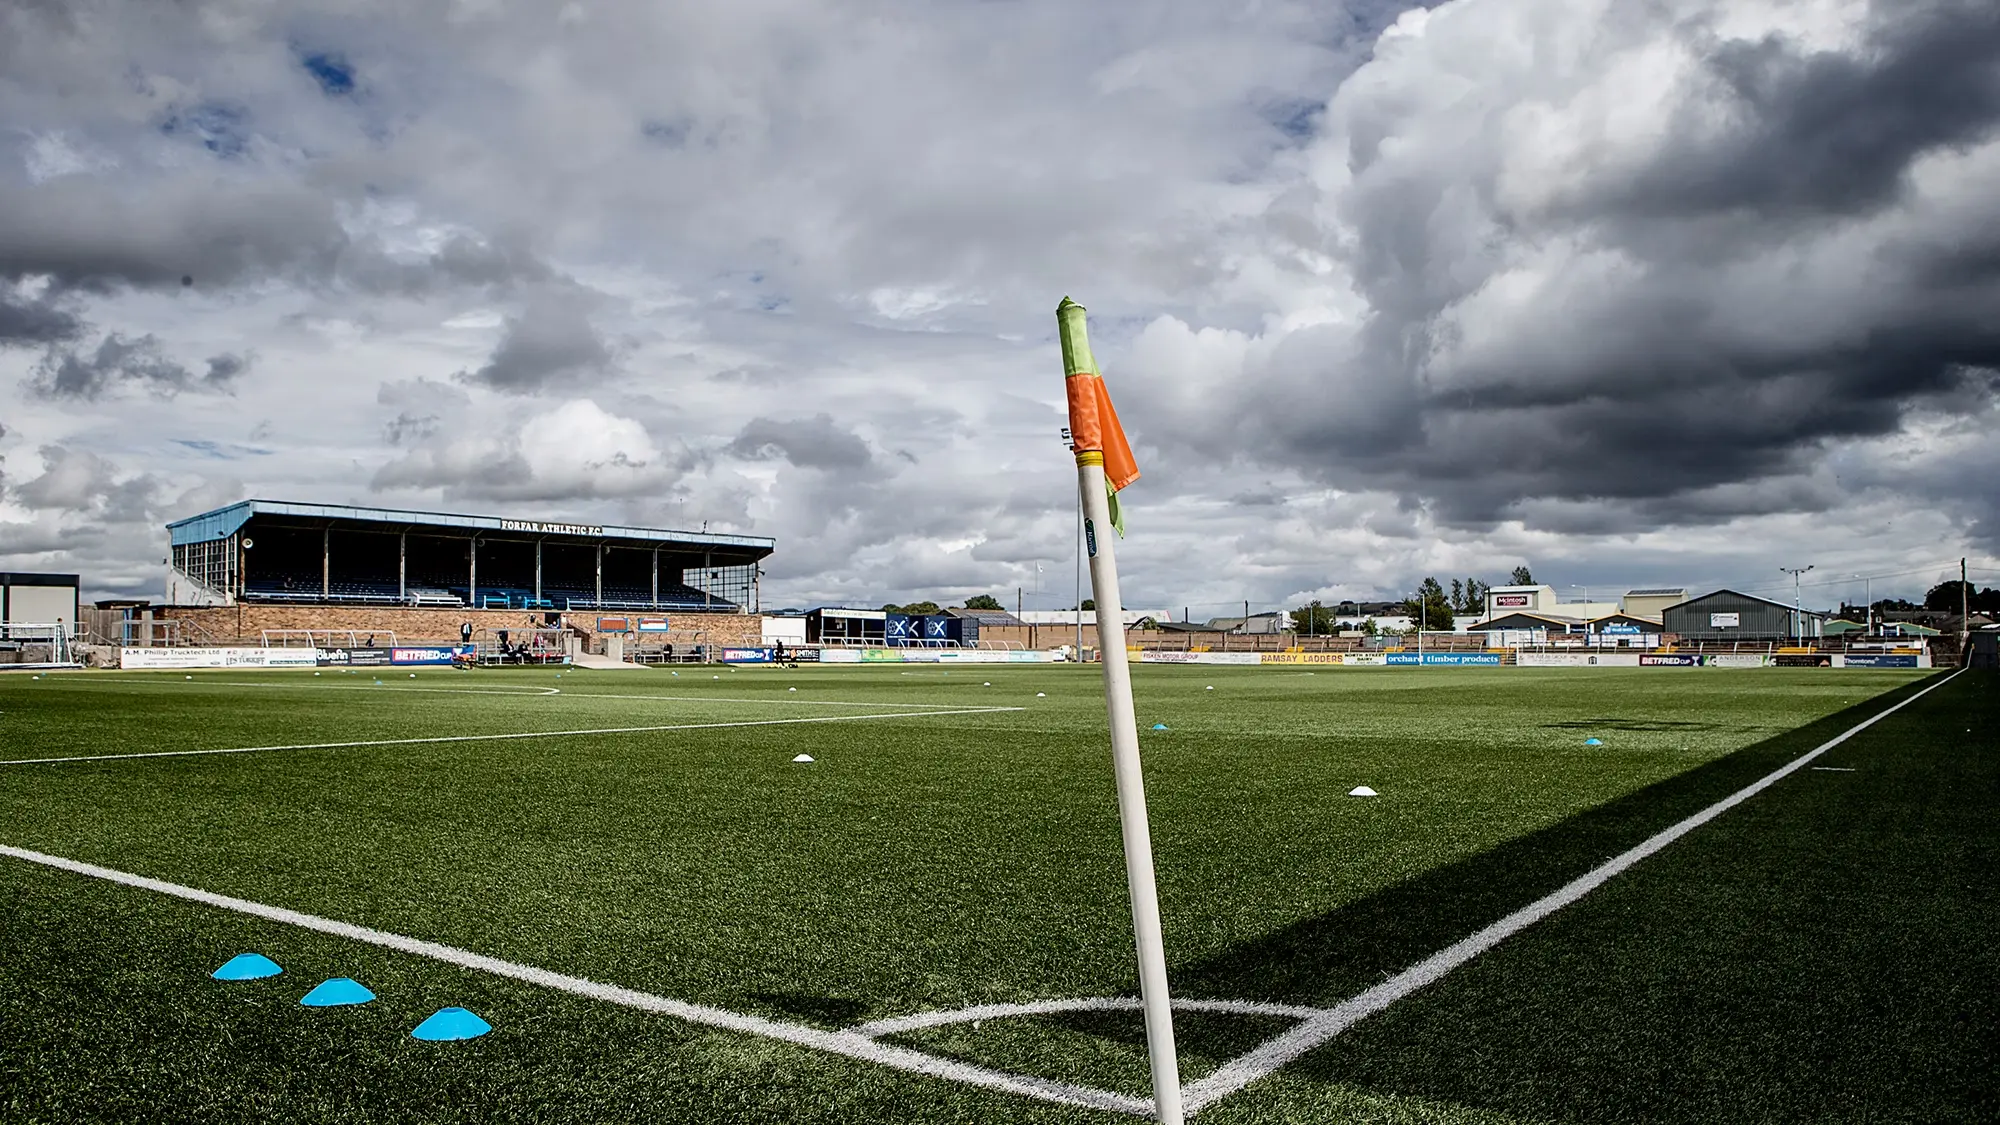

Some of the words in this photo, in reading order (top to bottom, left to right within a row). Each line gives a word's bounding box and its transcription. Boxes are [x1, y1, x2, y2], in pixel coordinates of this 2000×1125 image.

[501, 520, 539, 532] FORFAR
[541, 523, 587, 535] ATHLETIC
[316, 648, 349, 661] Bluefin
[395, 649, 440, 661] BETFRED
[440, 652, 452, 660] CUP
[725, 650, 756, 660] BETFRED
[1261, 654, 1297, 663] RAMSAY
[1303, 654, 1343, 663] LADDERS
[1427, 655, 1460, 664] timber
[1461, 655, 1498, 664] products
[1641, 656, 1680, 665] BETFRED
